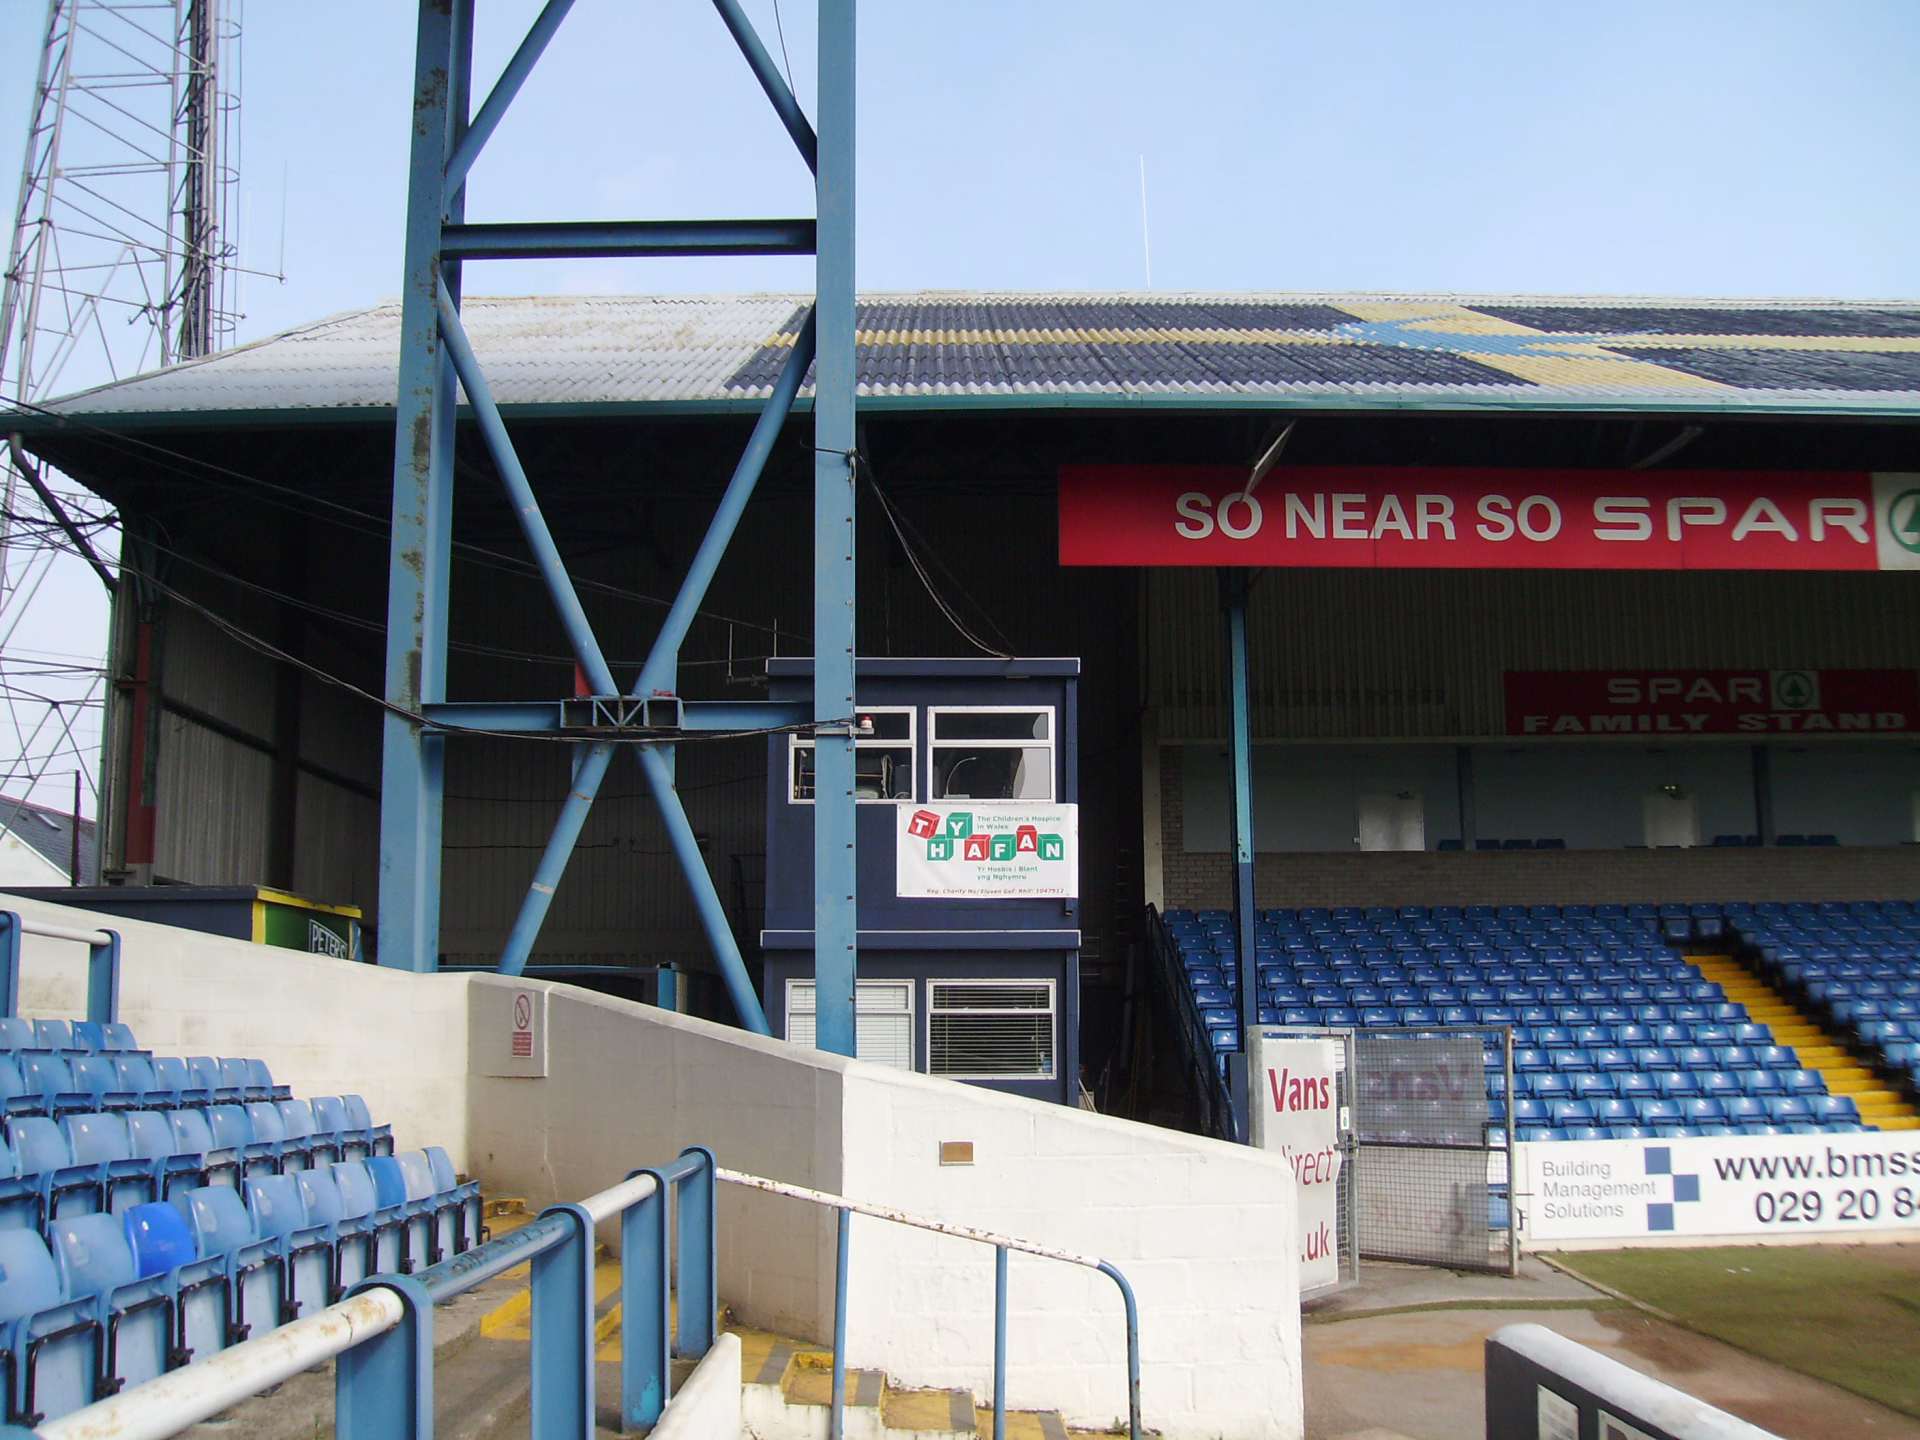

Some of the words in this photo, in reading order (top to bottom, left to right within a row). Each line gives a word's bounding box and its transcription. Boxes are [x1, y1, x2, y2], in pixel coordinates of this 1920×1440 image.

[1174, 492, 1263, 540] SO
[1285, 493, 1456, 541] NEAR
[1476, 494, 1562, 543] SO
[1593, 496, 1870, 544] SPAR
[1608, 677, 1763, 704] SPAR
[1523, 715, 1710, 732] FAMILY
[1738, 711, 1906, 731] STAND
[1032, 815, 1061, 823] Hospice
[931, 834, 1060, 858] HAFAN
[1268, 1068, 1330, 1112] Vans
[1282, 1144, 1334, 1185] irect
[1543, 1161, 1611, 1180] Building
[1543, 1181, 1657, 1200] Management
[1544, 1202, 1624, 1219] Solutions
[1755, 1191, 1822, 1223] 029
[1838, 1189, 1879, 1220] 20
[1893, 1187, 1920, 1218] 8
